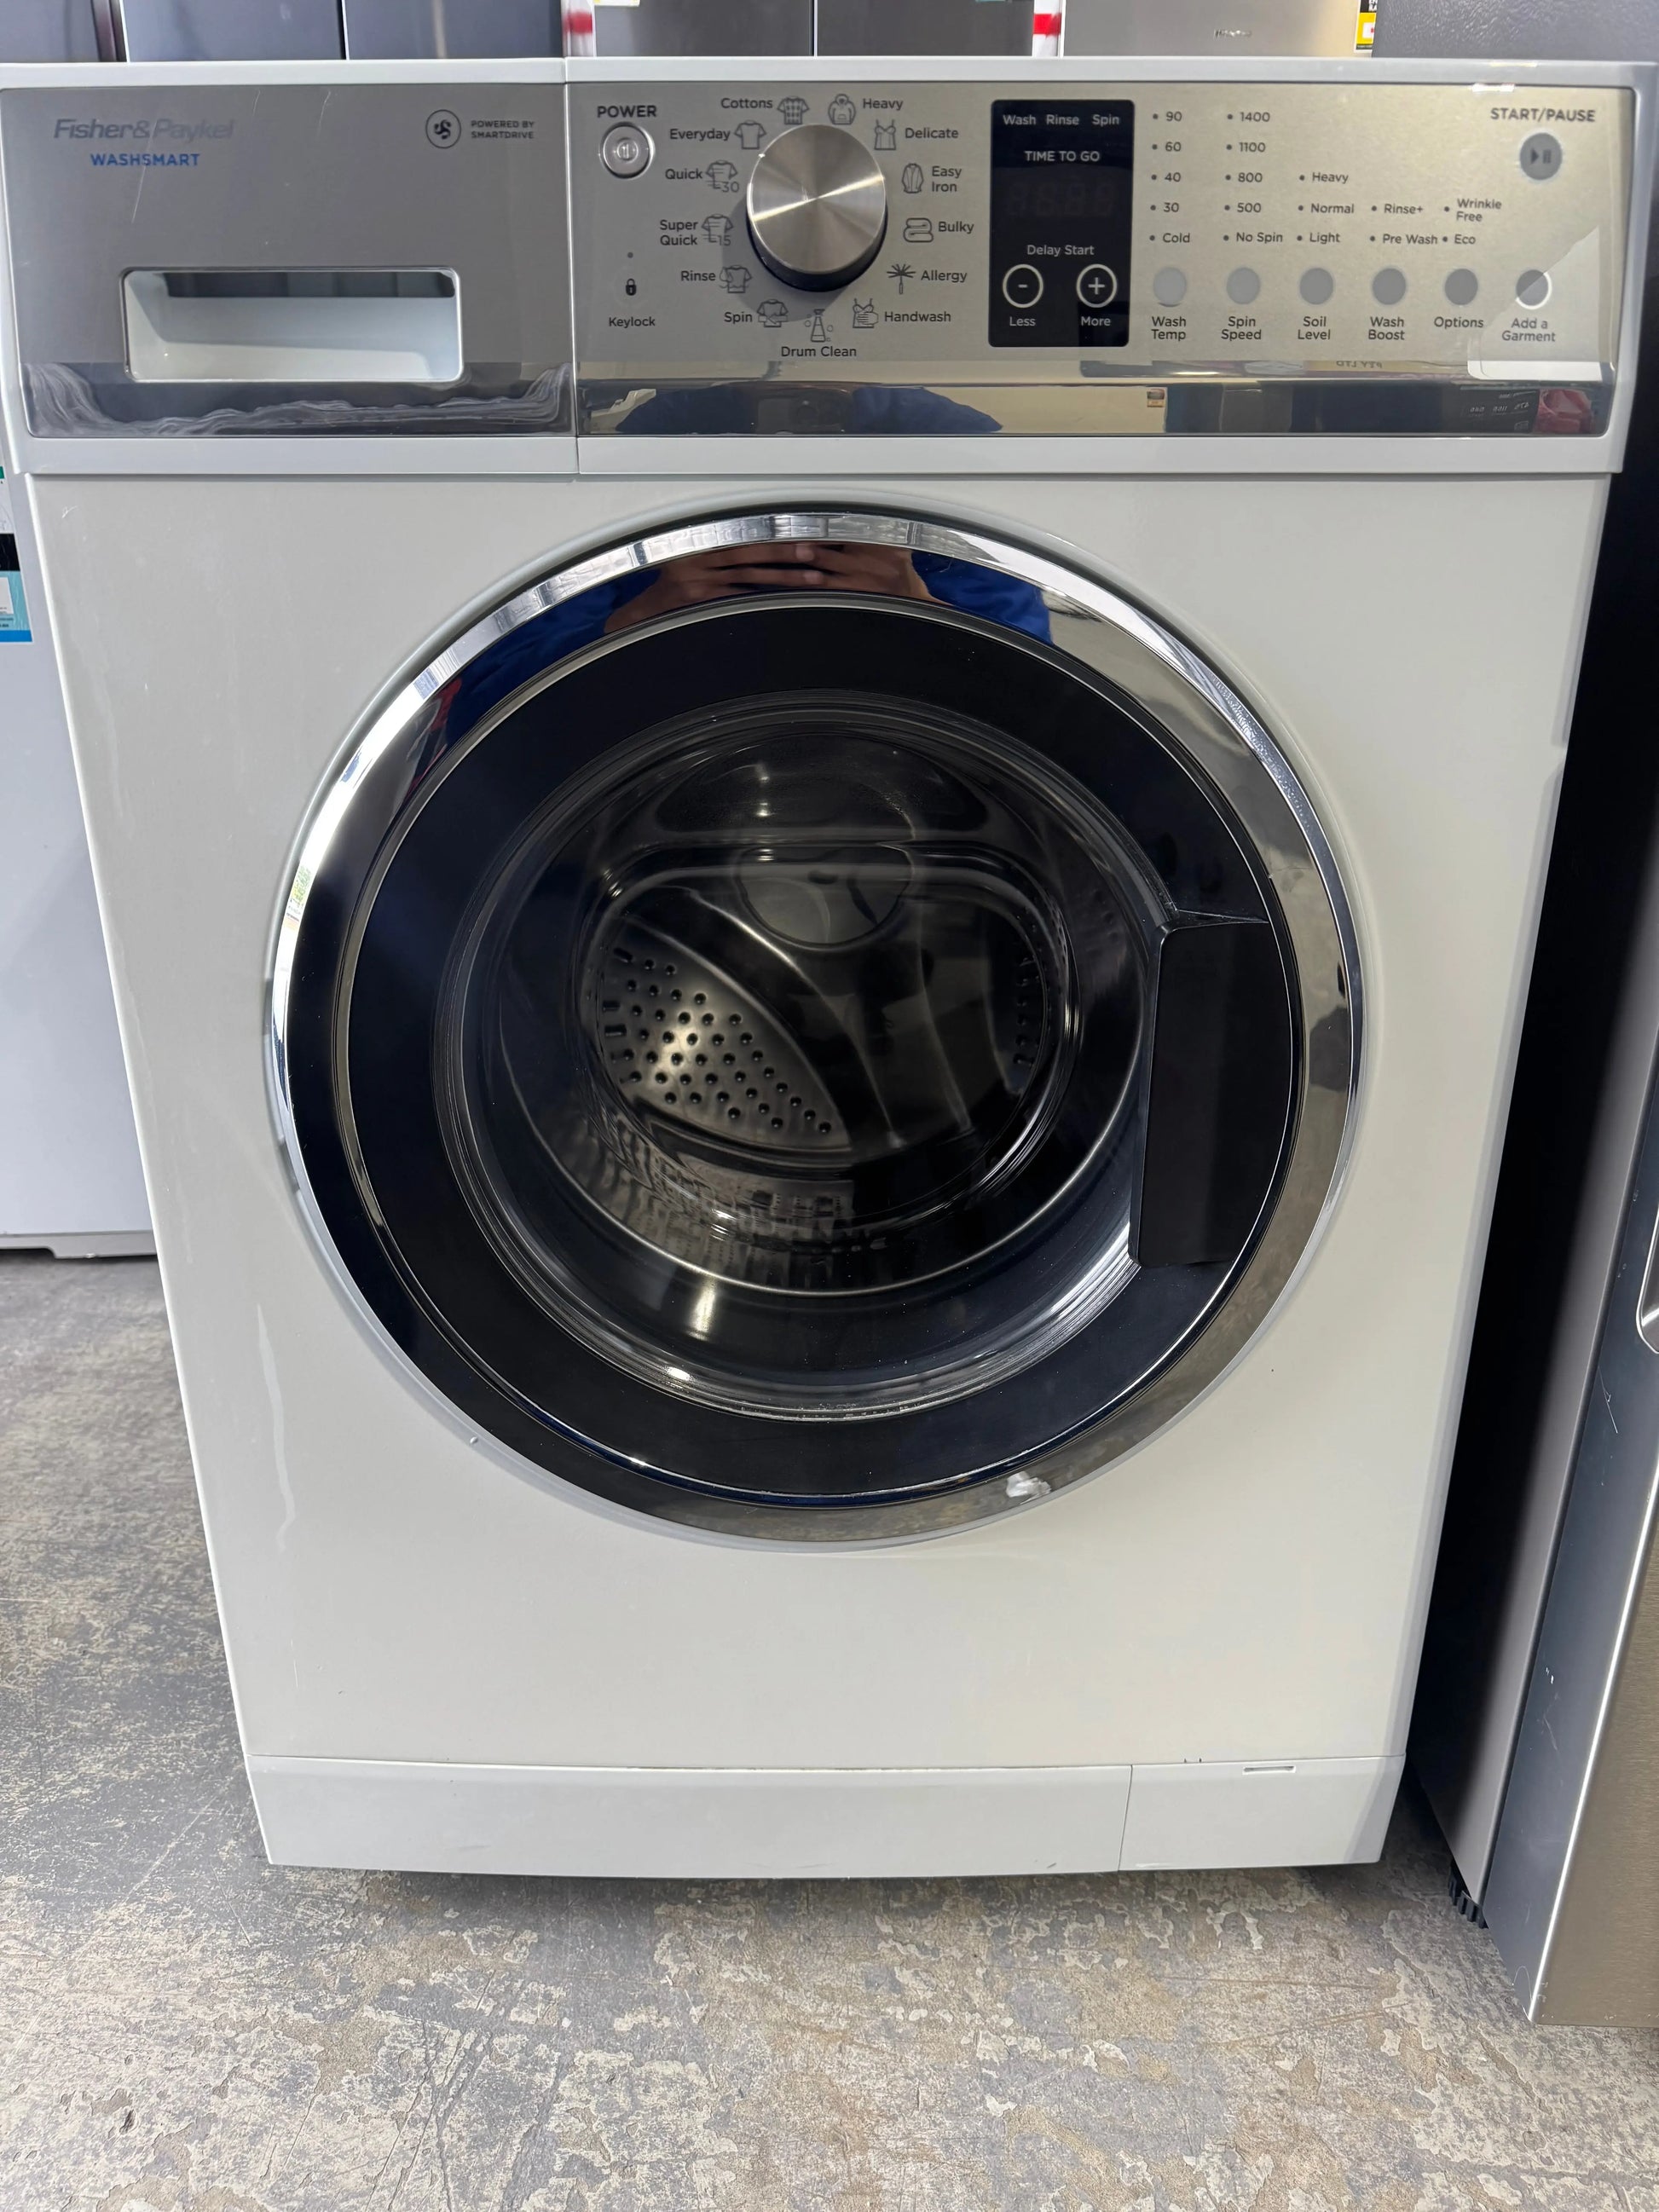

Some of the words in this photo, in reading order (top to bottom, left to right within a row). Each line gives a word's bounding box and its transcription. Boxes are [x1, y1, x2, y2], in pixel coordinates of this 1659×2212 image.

[720, 98, 772, 108] Cottons
[863, 99, 903, 111] Heavy
[598, 105, 656, 118] POWER
[1166, 112, 1182, 121] 90
[1240, 112, 1270, 122] 1400
[1491, 108, 1595, 123] START/PAUSE
[522, 120, 535, 129] BY
[1003, 114, 1036, 124] Wash
[1046, 114, 1079, 124] Rinse
[1092, 114, 1119, 126] Spin
[471, 130, 535, 139] SMARTDRIVE
[670, 129, 730, 141] Everyday
[905, 128, 958, 138] Delicate
[1165, 141, 1181, 152] 60
[1240, 142, 1266, 153] 1100
[90, 153, 201, 166] WASHSMART
[1025, 151, 1055, 161] TIME
[1059, 151, 1076, 161] TO
[1080, 151, 1100, 161] GO
[665, 169, 702, 179] Quick
[932, 165, 962, 178] Easy
[1165, 172, 1181, 182] 40
[1238, 172, 1263, 182] 800
[1312, 172, 1349, 184] Heavy
[932, 182, 957, 192] Iron
[1164, 202, 1179, 212] 30
[1237, 203, 1261, 212] 500
[1311, 204, 1354, 213] Normal
[1457, 199, 1501, 210] Wrinkle
[1456, 211, 1483, 222] Free
[660, 220, 698, 233] Super
[939, 221, 974, 234] Bulky
[660, 234, 697, 245] Quick
[1163, 233, 1190, 243] Cold
[1236, 233, 1252, 242] No
[1257, 232, 1282, 244] Spin
[1309, 233, 1340, 244] Light
[1383, 234, 1402, 244] Pre
[1406, 234, 1437, 244] Wash
[1454, 234, 1476, 245] Eco
[1027, 245, 1061, 257] Delay
[1065, 245, 1094, 255] Start
[681, 270, 715, 281] Rinse
[921, 270, 967, 283] Allergy
[725, 312, 752, 324] Spin
[885, 311, 951, 321] Handwash
[1009, 317, 1036, 326] Less
[1081, 316, 1111, 326] More
[1151, 316, 1186, 327] Wash
[609, 316, 655, 328] Keylock
[1228, 316, 1256, 329] Spin
[1304, 316, 1327, 328] Soil
[1369, 317, 1404, 328] Wash
[1434, 316, 1483, 329] Options
[1511, 318, 1537, 330] Add
[1539, 319, 1547, 329] a
[1151, 329, 1186, 341] Temp
[1221, 328, 1261, 341] Speed
[1298, 329, 1330, 339] Level
[1368, 329, 1405, 340] Boost
[1502, 331, 1555, 342] Garment
[782, 346, 816, 356] Drum
[821, 346, 856, 356] Clean
